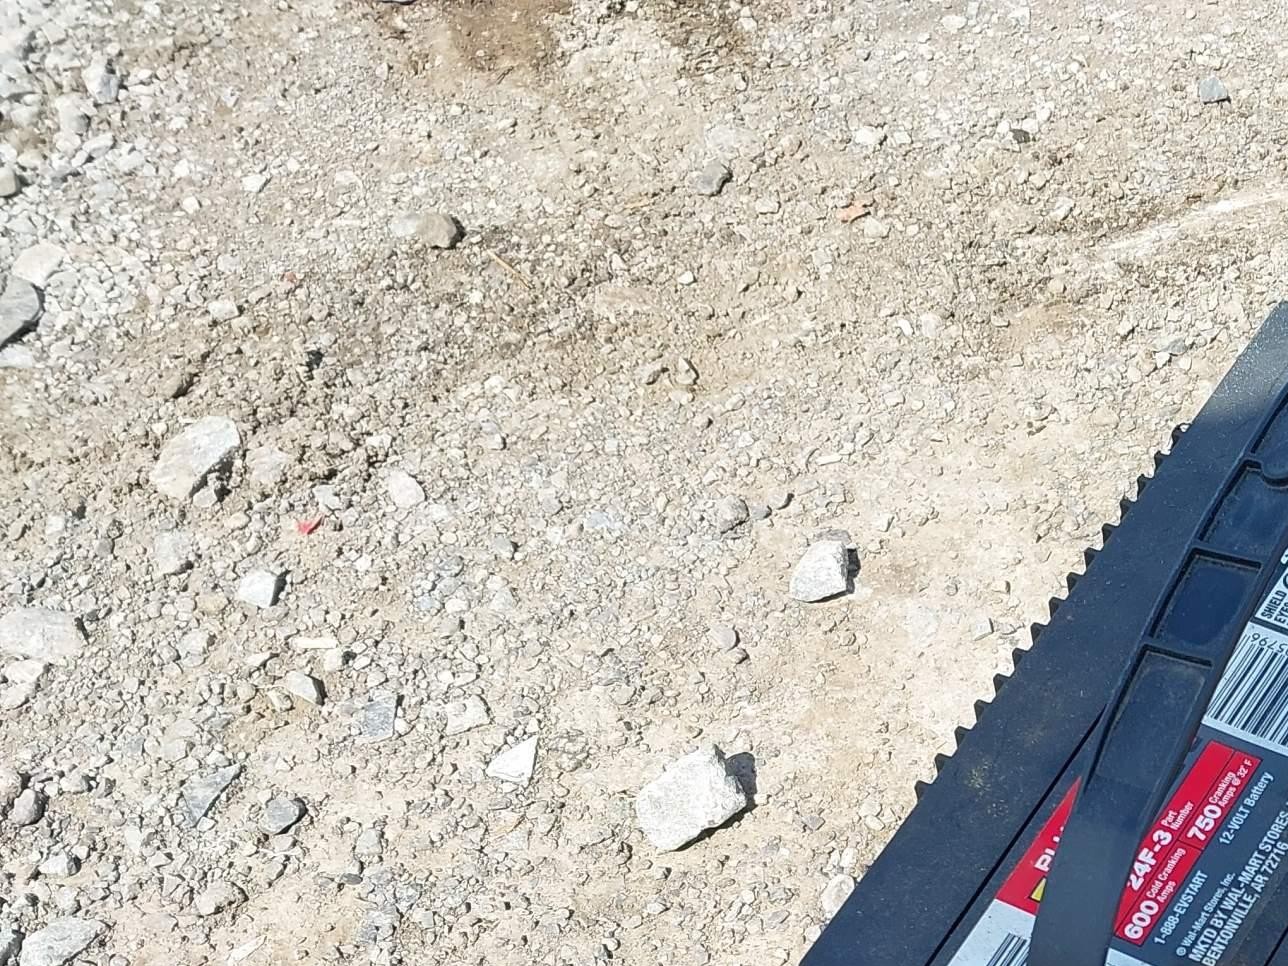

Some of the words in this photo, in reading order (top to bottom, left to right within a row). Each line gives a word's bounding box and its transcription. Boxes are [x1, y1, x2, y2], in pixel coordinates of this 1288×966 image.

[1260, 589, 1287, 619] SHIELD
[1207, 770, 1237, 804] Cranking
[1216, 785, 1238, 808] Amps
[1243, 758, 1254, 766] F
[1159, 809, 1177, 827] Part
[1169, 800, 1195, 830] Number
[1185, 801, 1224, 842] 750
[1218, 804, 1251, 845] 12-VOLT
[1242, 770, 1275, 808] Battery
[1125, 828, 1174, 891] 24F-3
[1145, 879, 1163, 898] Cold
[1157, 846, 1187, 882] Cranking
[1155, 879, 1177, 903] Amps
[1249, 873, 1269, 892] AR
[1121, 897, 1161, 941] 600
[1152, 869, 1209, 946] 1-888-EVSTART
[1180, 910, 1210, 947] Wal-Mart
[1203, 884, 1228, 913] Stores,
[1219, 870, 1236, 886] Inc.
[1187, 927, 1218, 962] MKTD
[1209, 909, 1229, 928] BY
[1220, 851, 1267, 911] WAL-MART
